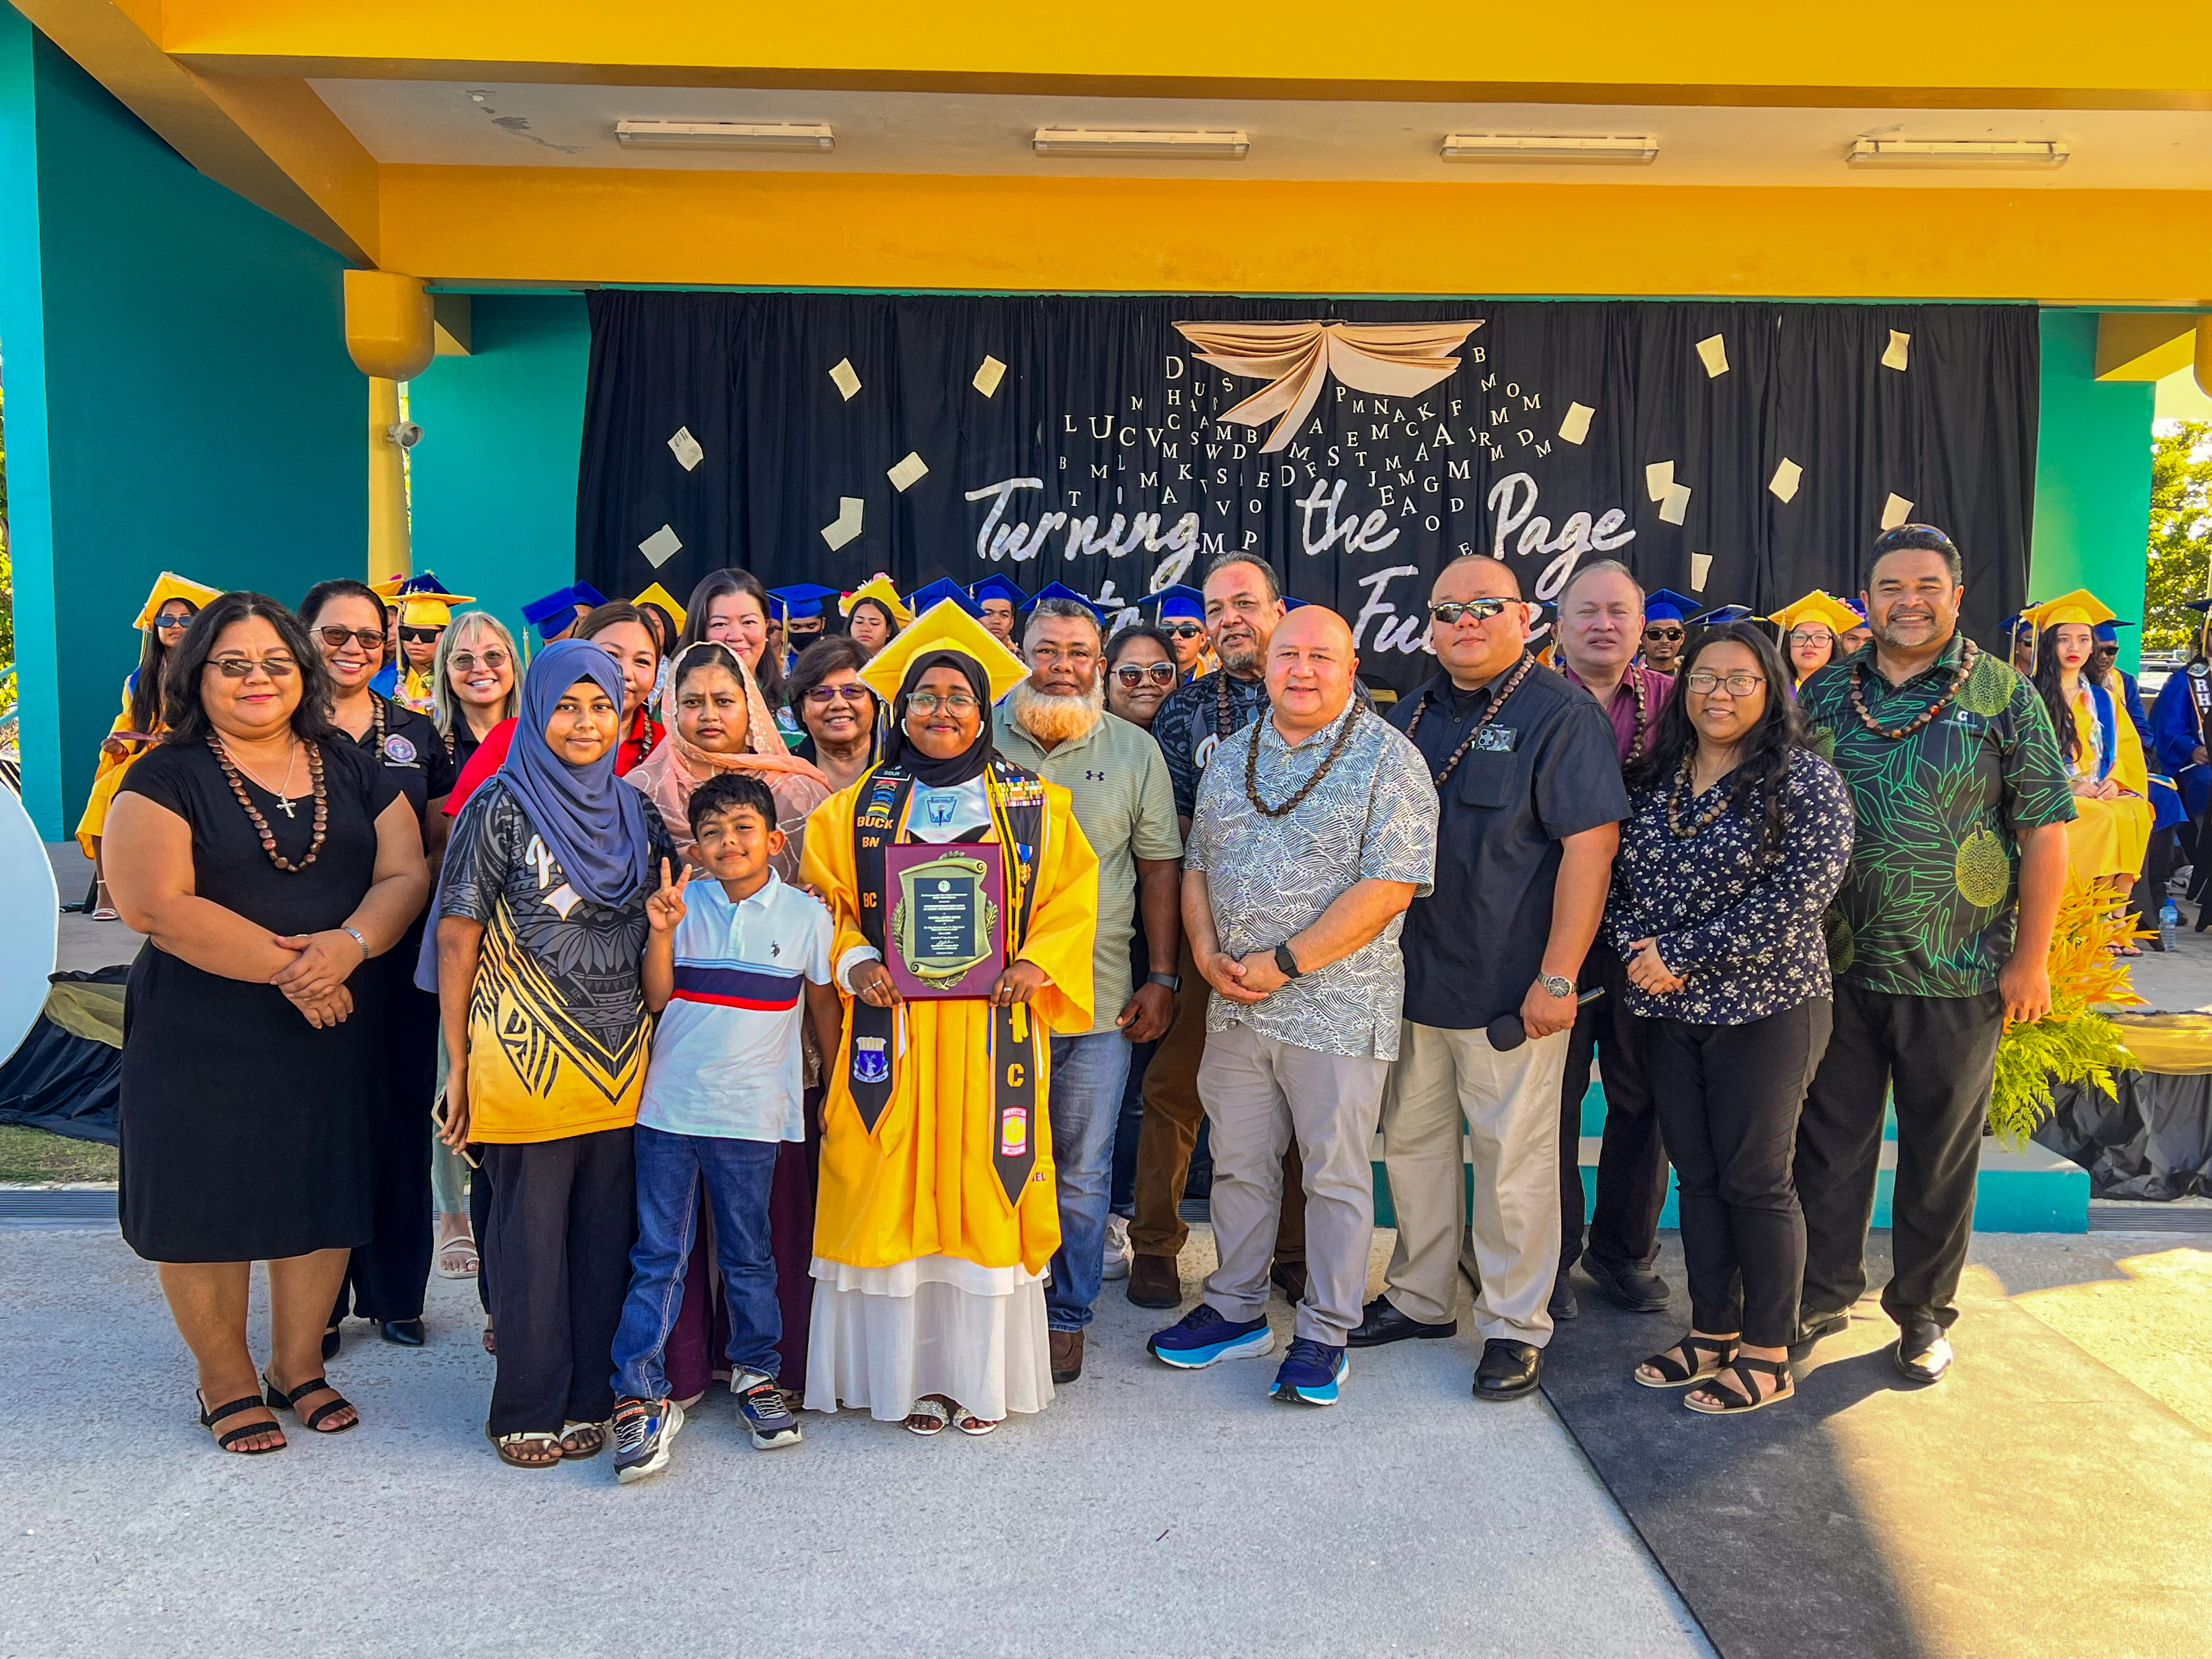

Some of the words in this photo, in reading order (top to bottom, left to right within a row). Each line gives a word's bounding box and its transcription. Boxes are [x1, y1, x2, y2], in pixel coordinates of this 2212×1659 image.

[1472, 347, 1486, 363] B
[1166, 355, 1184, 379] D
[1194, 382, 1206, 396] U
[1222, 377, 1233, 392] S
[1481, 373, 1497, 392] M
[1506, 383, 1520, 398] O
[1167, 389, 1181, 405] H
[1335, 386, 1346, 402] P
[1522, 393, 1542, 411] M
[1131, 396, 1143, 410] M
[1353, 399, 1365, 414] M
[1374, 398, 1390, 415] N
[1450, 399, 1462, 416] F
[1392, 408, 1406, 423] A
[1417, 402, 1436, 422] K
[1490, 407, 1510, 426] M
[1064, 415, 1077, 432] L
[1088, 415, 1115, 439] U
[1167, 414, 1180, 430] C
[1199, 415, 1209, 429] A
[1308, 417, 1323, 435] A
[1406, 421, 1419, 437] C
[1119, 426, 1136, 447] C
[1145, 427, 1164, 448] V
[1190, 431, 1199, 445] S
[1216, 425, 1232, 441] M
[1246, 429, 1257, 443] B
[1346, 431, 1359, 447] E
[1370, 423, 1390, 440] M
[1432, 422, 1455, 448] A
[1479, 432, 1493, 447] R
[1516, 428, 1534, 447] D
[1162, 442, 1178, 459] M
[1205, 444, 1223, 460] W
[1232, 444, 1246, 459] D
[1288, 442, 1311, 461] M
[1327, 445, 1340, 467] S
[1414, 442, 1430, 462] A
[1490, 444, 1505, 461] M
[1534, 439, 1552, 458] M
[1059, 456, 1066, 470] B
[1118, 454, 1126, 471] L
[1355, 451, 1367, 467] T
[1385, 455, 1402, 471] M
[1090, 464, 1108, 479] M
[1178, 464, 1193, 480] K
[1216, 468, 1227, 484] S
[1280, 465, 1296, 487] D
[1305, 461, 1317, 479] F
[1447, 459, 1471, 479] M
[1139, 471, 1159, 488] M
[1256, 471, 1270, 488] E
[1368, 471, 1377, 488] J
[1398, 469, 1415, 487] M
[1424, 476, 1440, 493] G
[1068, 490, 1081, 506] T
[1161, 486, 1178, 505] A
[1378, 484, 1395, 507] E
[1215, 500, 1231, 516] V
[1249, 499, 1262, 514] O
[1400, 496, 1418, 517] A
[1449, 498, 1464, 512] D
[1425, 515, 1440, 532] O
[964, 477, 1200, 594] Turning
[1295, 478, 1400, 556] the
[1487, 472, 1637, 601] Page
[1200, 532, 1226, 554] M
[1241, 529, 1257, 551] P
[1458, 541, 1472, 556] E
[857, 816, 894, 829] BUCK
[862, 837, 880, 848] BN
[862, 892, 877, 908] BC
